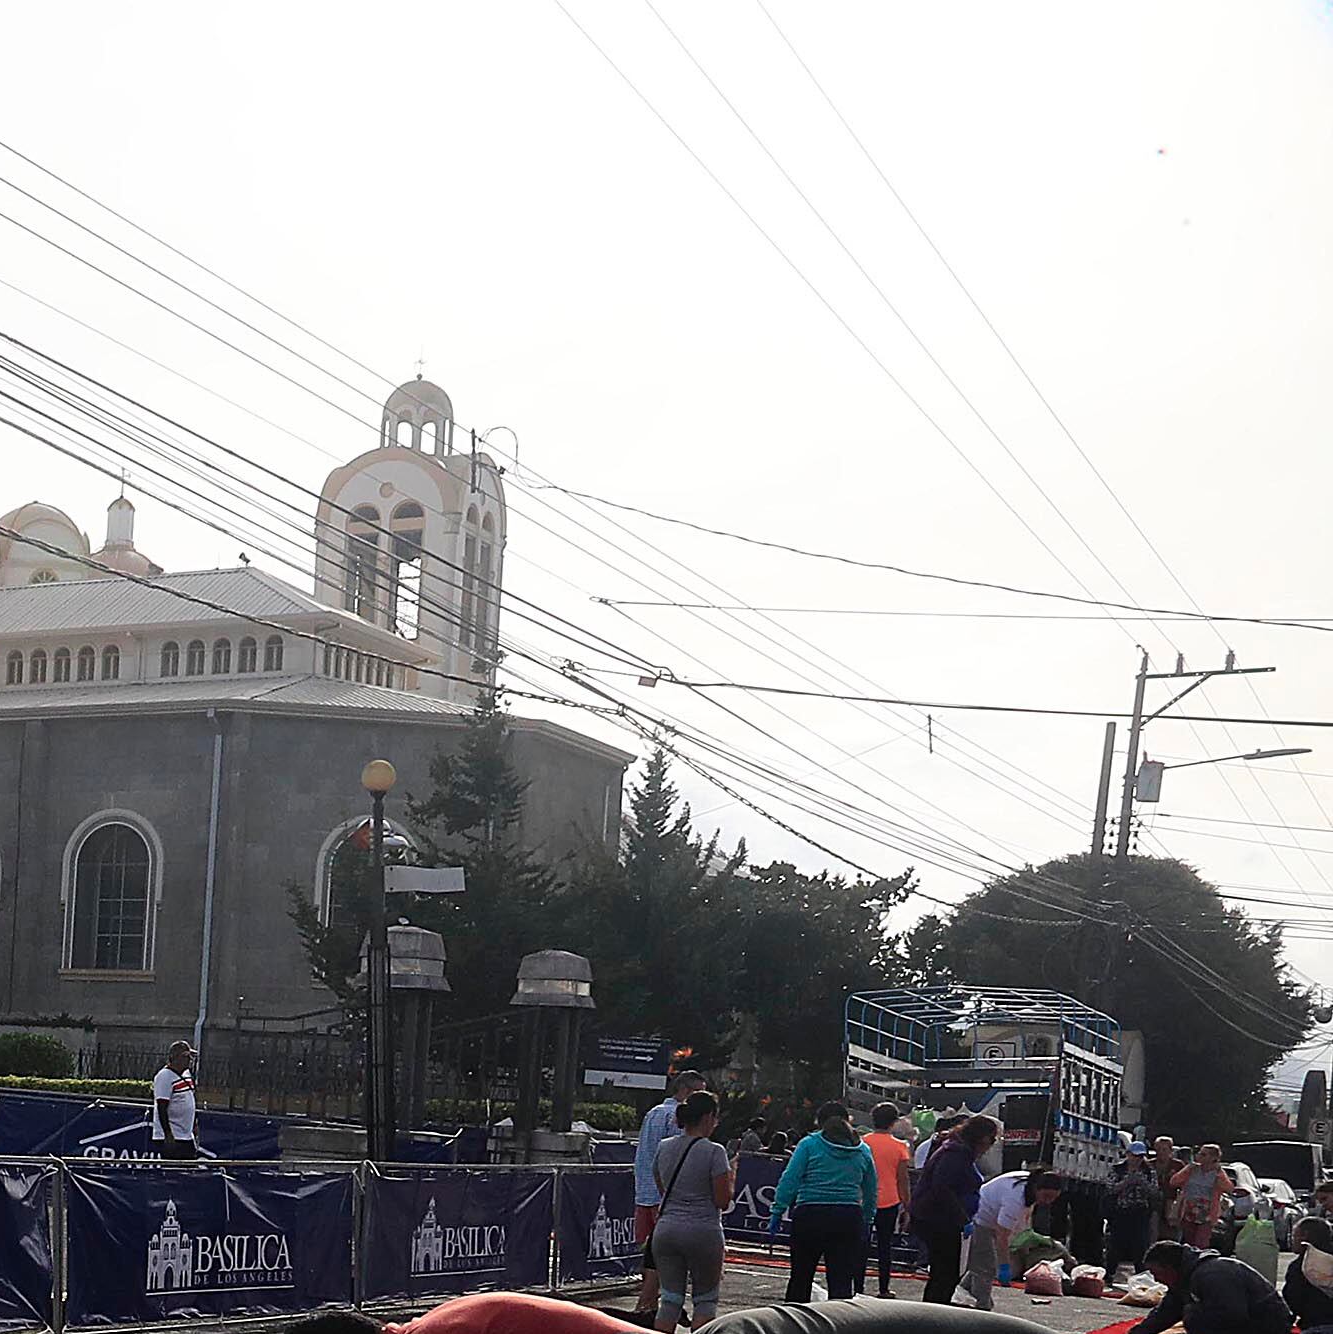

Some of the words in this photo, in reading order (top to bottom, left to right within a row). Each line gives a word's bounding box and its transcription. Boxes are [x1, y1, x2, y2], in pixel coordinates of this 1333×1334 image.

[194, 1234, 294, 1273] BASILICA
[443, 1225, 505, 1258] BASILICA
[194, 1274, 210, 1285] DE
[217, 1272, 238, 1284] LOS
[243, 1270, 293, 1282] ANGELES
